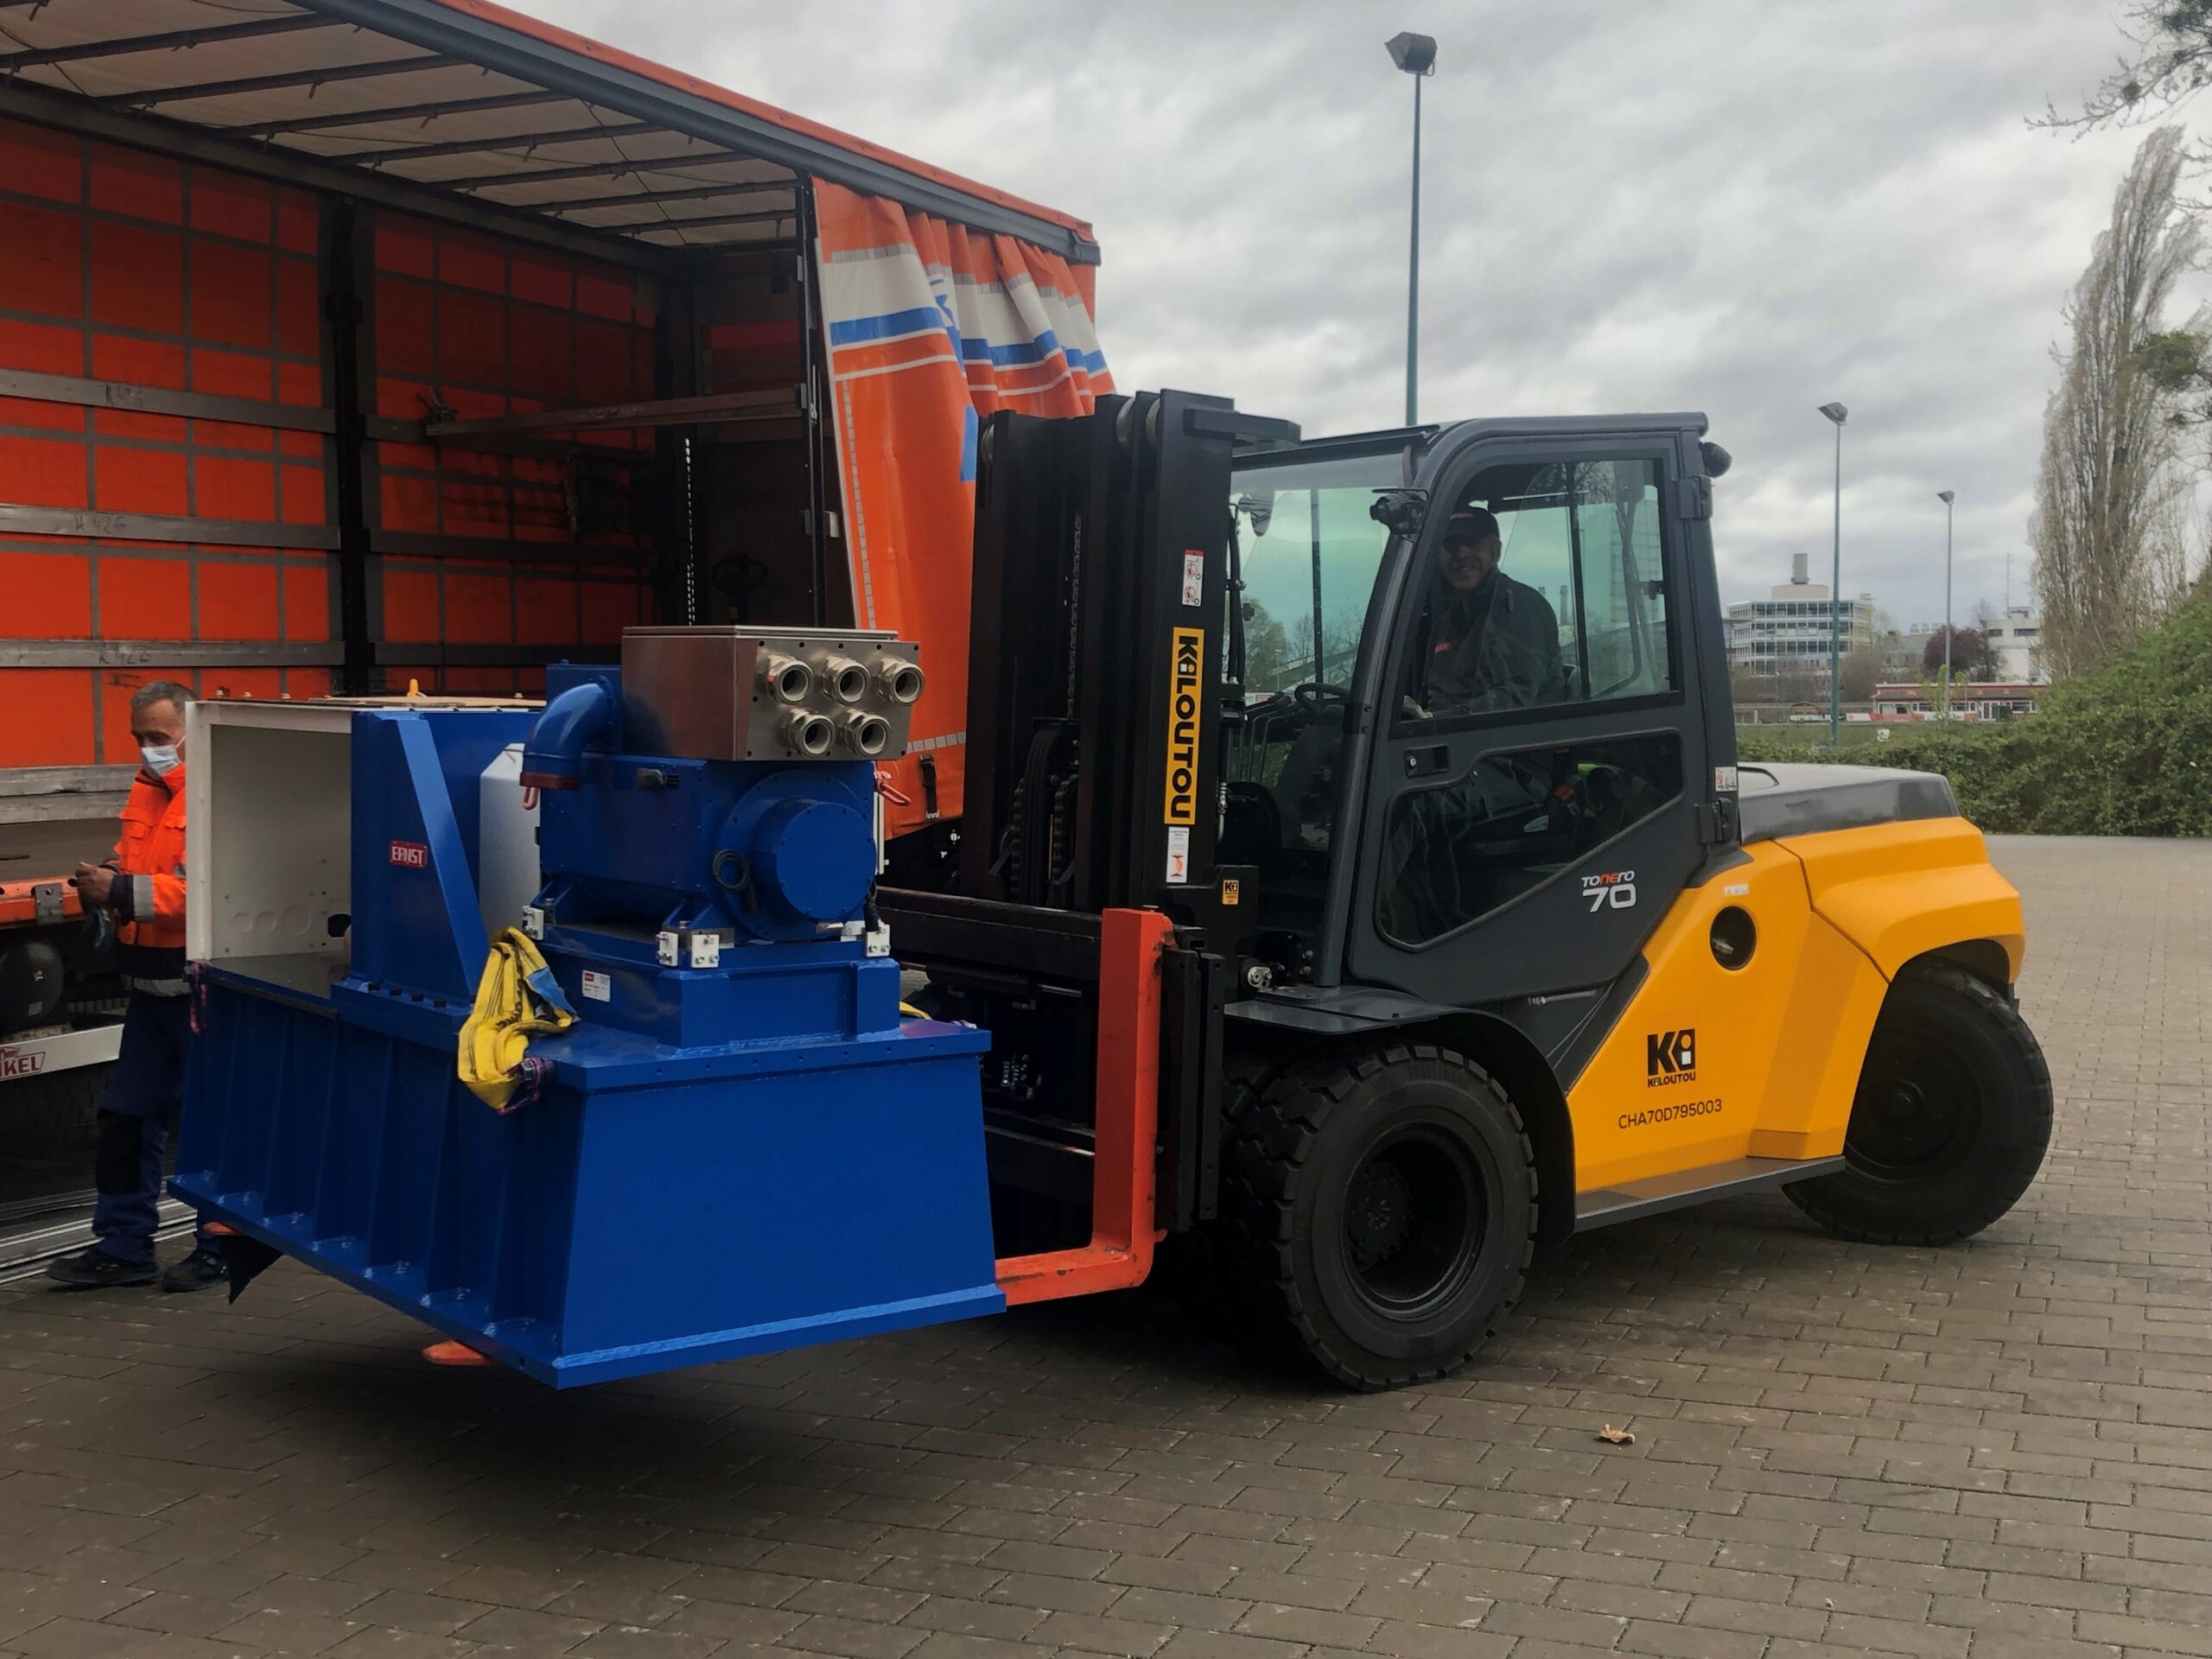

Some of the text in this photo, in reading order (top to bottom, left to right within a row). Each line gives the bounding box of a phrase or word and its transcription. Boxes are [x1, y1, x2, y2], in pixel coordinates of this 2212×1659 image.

[391, 846, 424, 864] ERNST
[1582, 883, 1637, 912] 70
[0, 1056, 40, 1077] KEL
[1618, 1098, 1722, 1129] CHA70D795003
